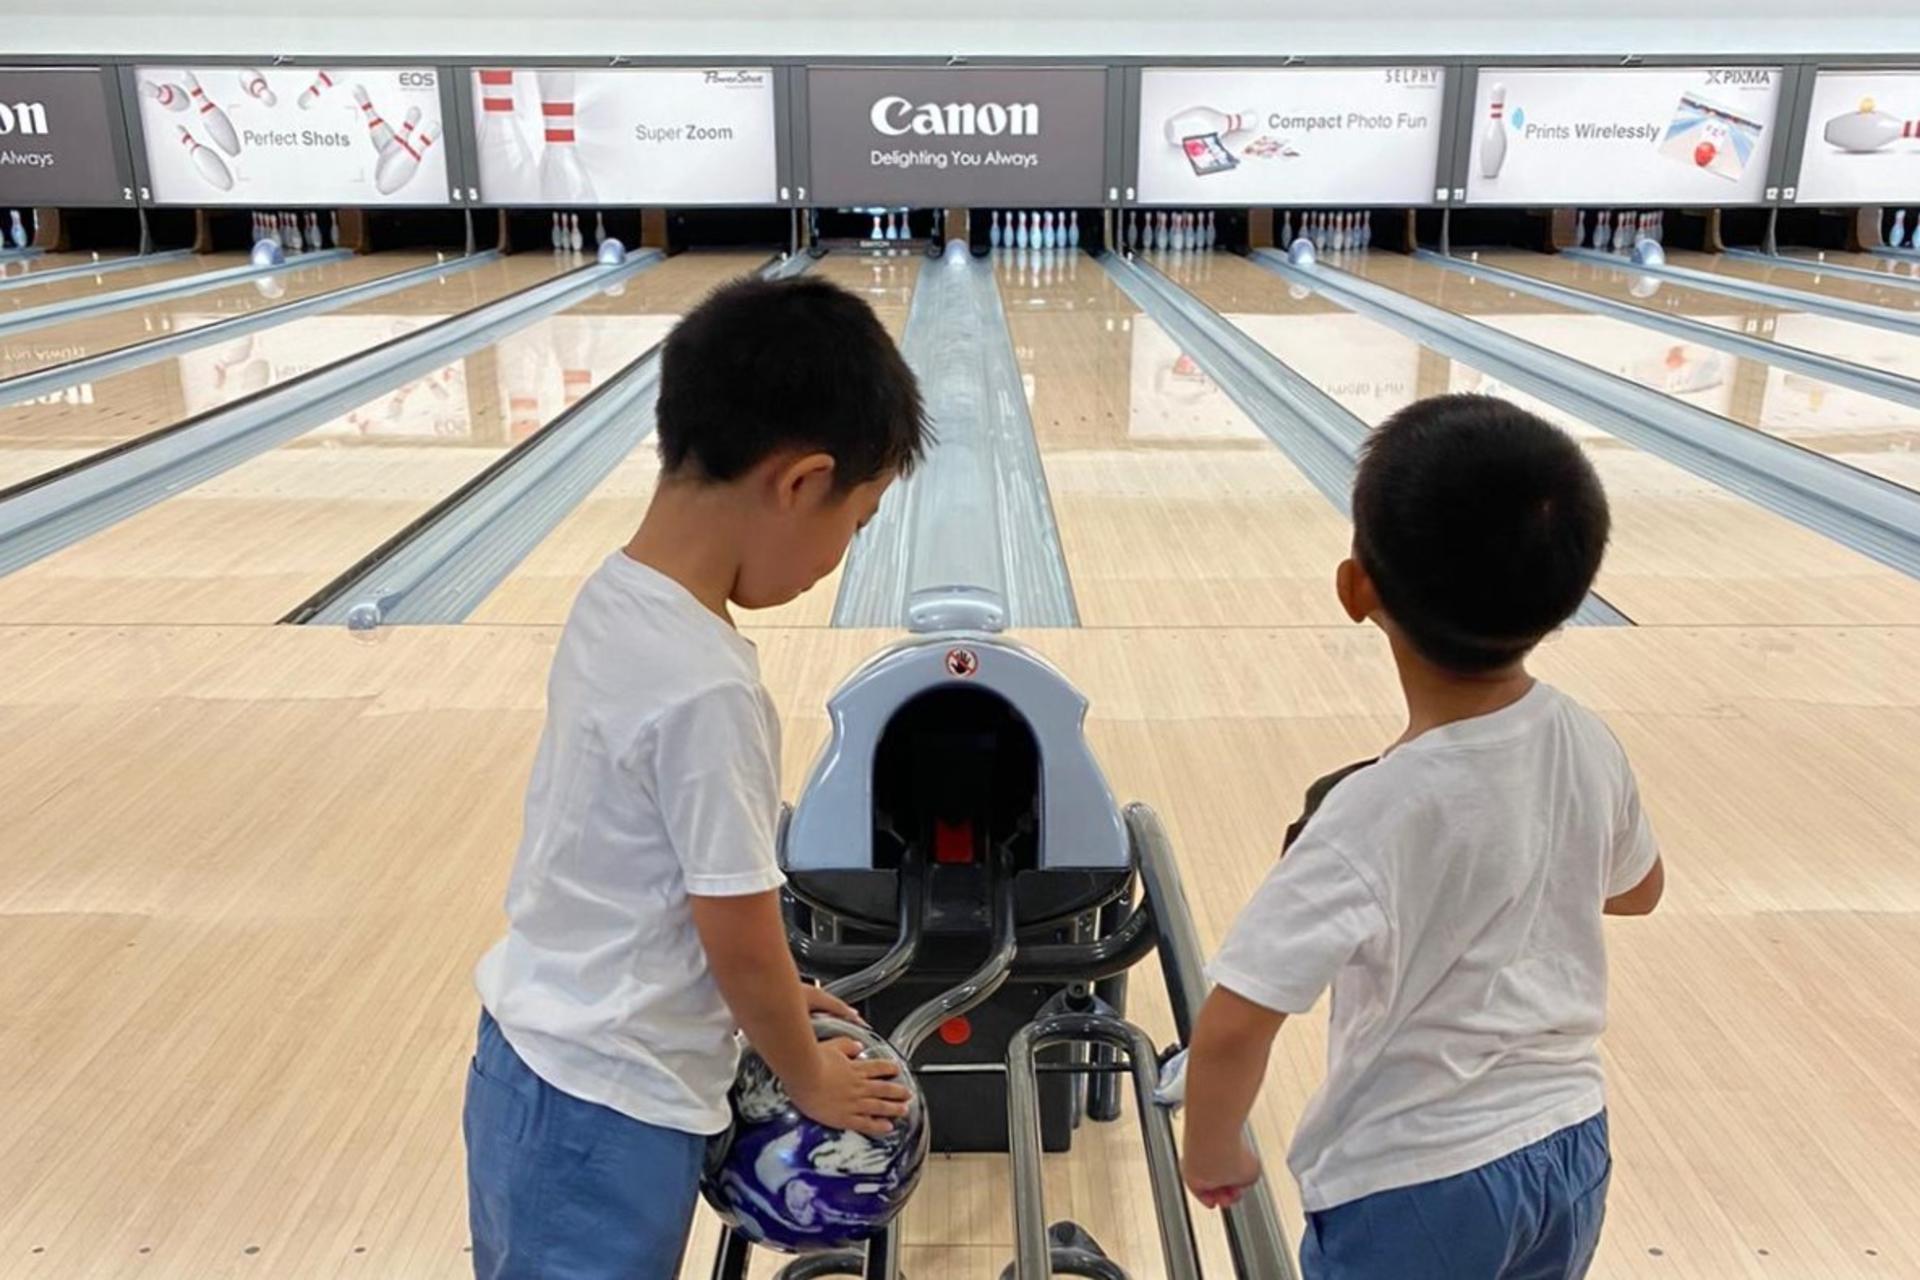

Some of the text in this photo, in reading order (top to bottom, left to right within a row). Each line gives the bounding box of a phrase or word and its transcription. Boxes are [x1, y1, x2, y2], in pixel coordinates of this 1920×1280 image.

[399, 72, 435, 88] EOS
[1384, 69, 1439, 84] SELPHY
[1723, 69, 1771, 84] PIXMA
[870, 95, 1040, 136] Canon
[1267, 112, 1428, 134] Compact Photo Fun
[243, 130, 351, 148] Perfect Shots
[634, 124, 734, 143] Super Zoom
[1525, 122, 1661, 143] Prints Wirelessly
[0, 150, 55, 168] Always
[870, 150, 1039, 169] Delighting You Always
[124, 187, 132, 200] 2
